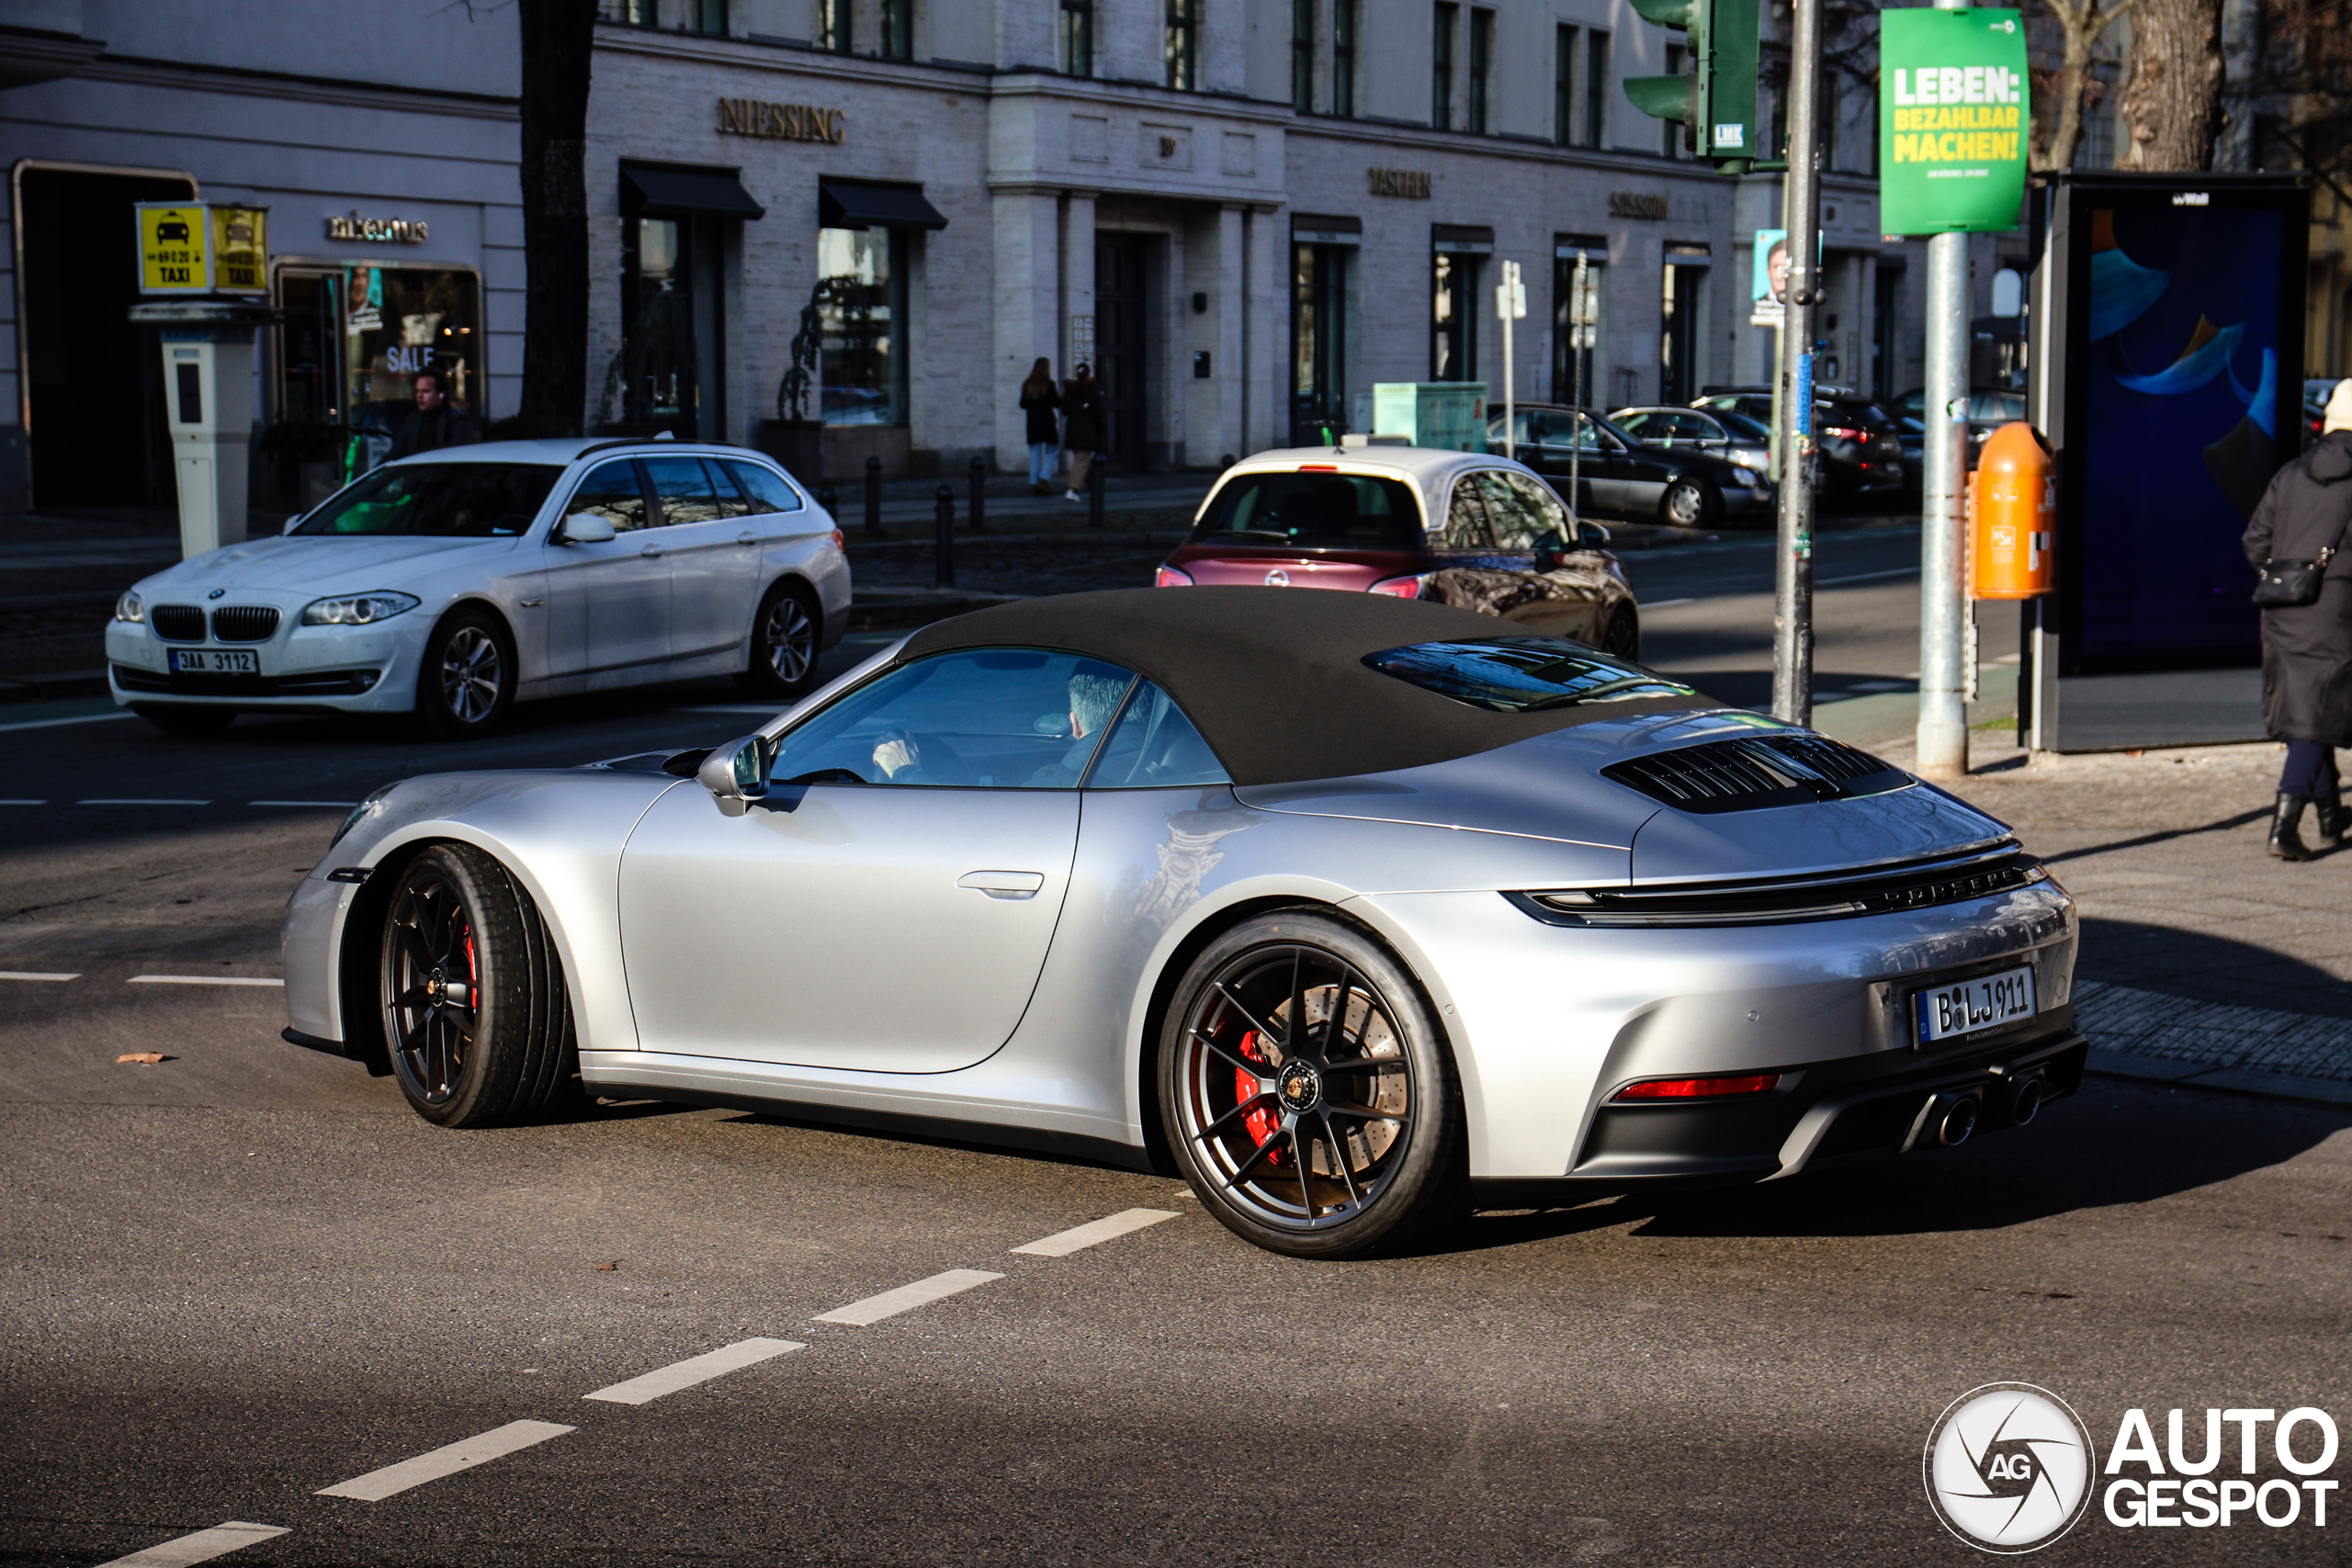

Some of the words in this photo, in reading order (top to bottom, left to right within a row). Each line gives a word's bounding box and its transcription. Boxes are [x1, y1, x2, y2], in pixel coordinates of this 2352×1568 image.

[1894, 66, 2020, 106] LEBEN:
[717, 96, 846, 143] NIESSING
[1894, 106, 2020, 131] BEZAHLBAR
[1715, 125, 1744, 142] LMK
[1894, 131, 2020, 163] MACHEN!
[1368, 167, 1431, 198] TASCHEN
[160, 267, 190, 283] TAXI
[228, 267, 254, 286] TAXI
[180, 653, 205, 669] 3AA
[215, 653, 250, 670] 3112
[1937, 992, 1953, 1033] B
